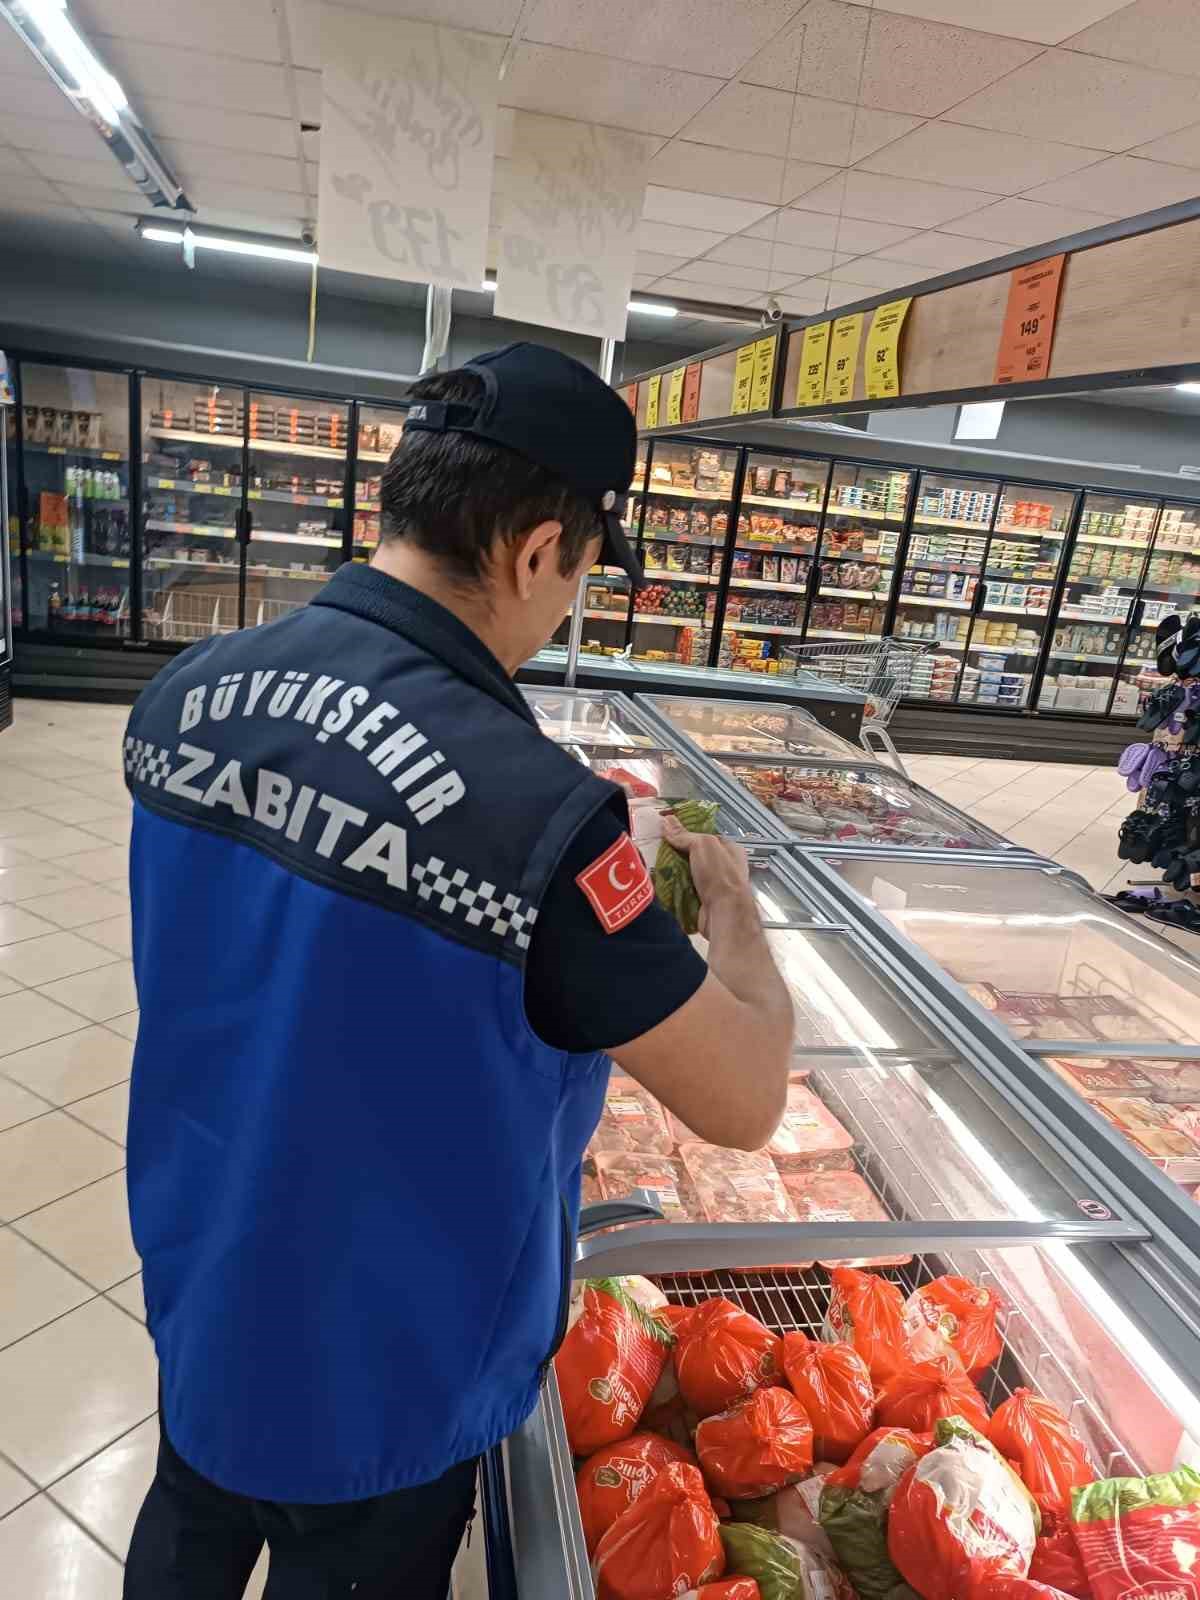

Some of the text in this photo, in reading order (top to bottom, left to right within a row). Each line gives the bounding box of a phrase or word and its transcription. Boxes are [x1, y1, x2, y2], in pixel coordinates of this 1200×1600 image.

[1020, 319, 1039, 337] 149
[164, 742, 408, 891] ZABITA
[179, 670, 467, 825] BÜYÜKŞEHİR
